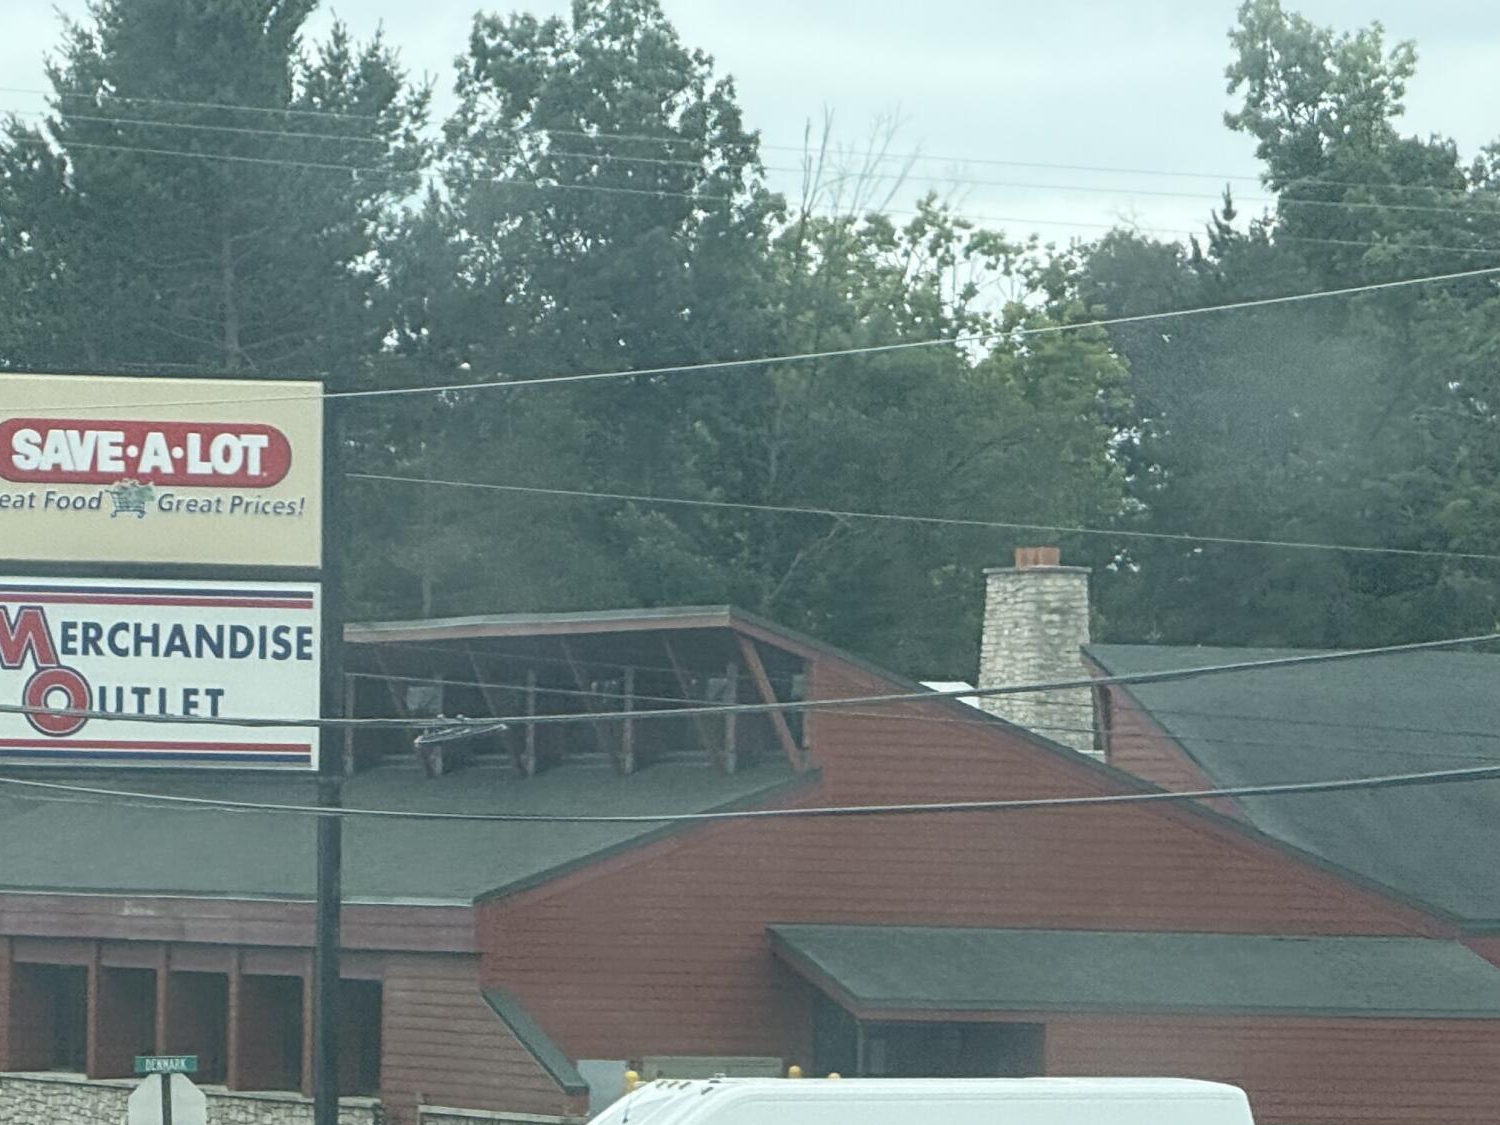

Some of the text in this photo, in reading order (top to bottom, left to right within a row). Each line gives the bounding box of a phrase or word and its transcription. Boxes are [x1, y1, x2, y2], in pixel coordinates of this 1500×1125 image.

[44, 489, 104, 511] Food
[158, 493, 306, 517] Great Prices!
[22, 665, 225, 738] OUTLET
[144, 1058, 188, 1072] DENMARK
